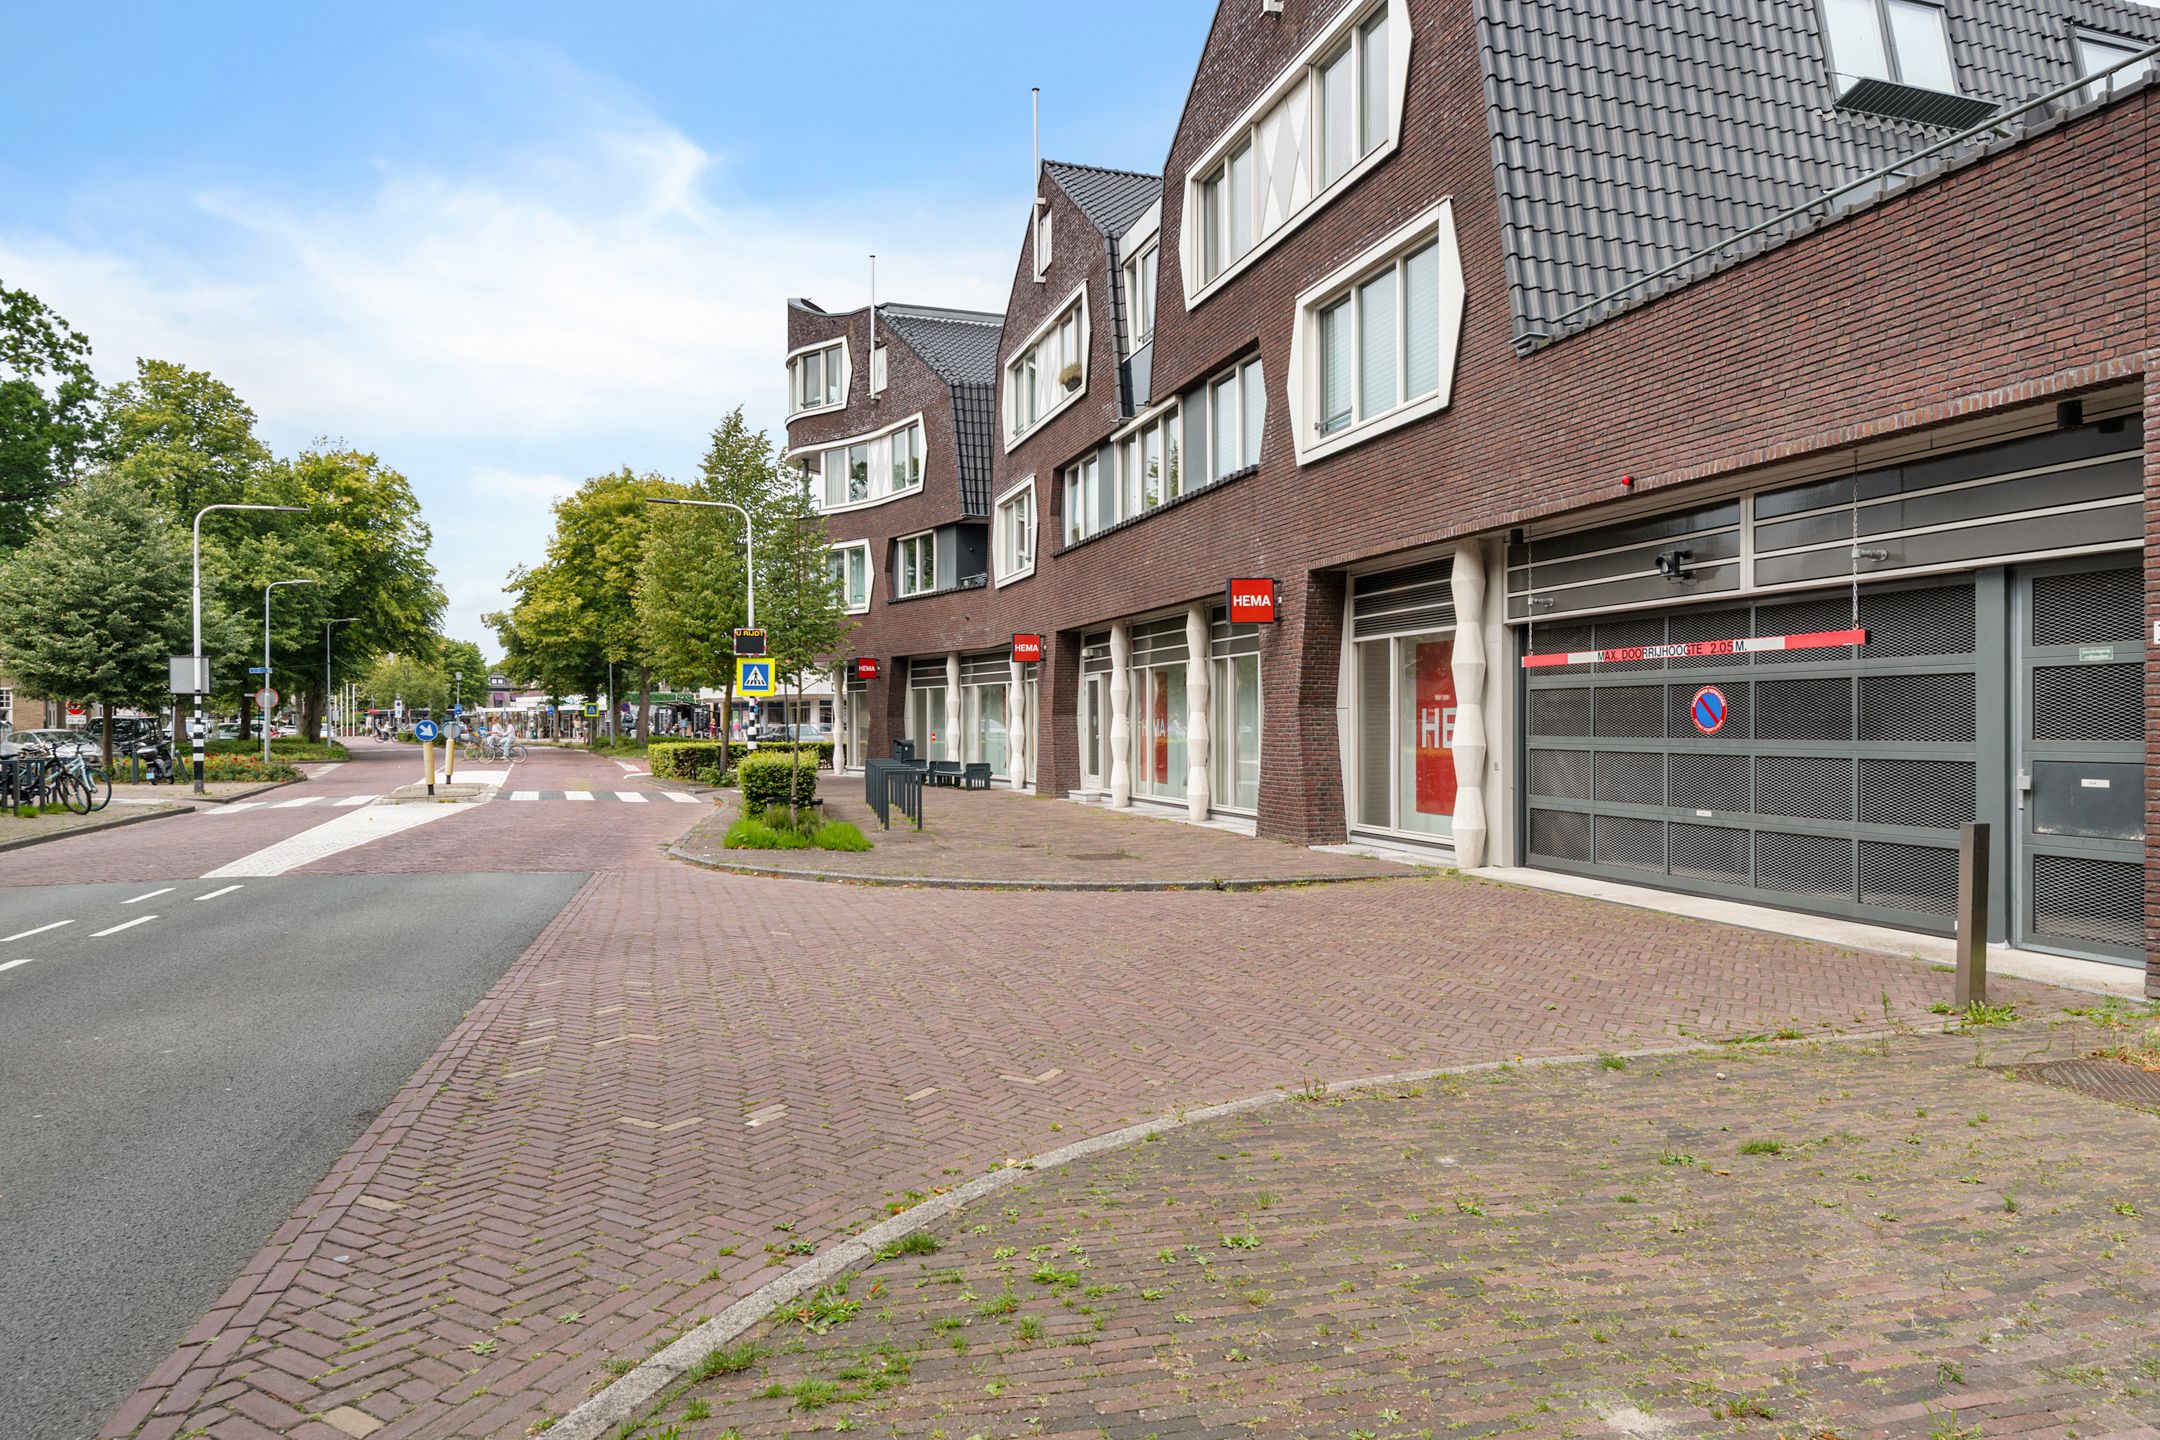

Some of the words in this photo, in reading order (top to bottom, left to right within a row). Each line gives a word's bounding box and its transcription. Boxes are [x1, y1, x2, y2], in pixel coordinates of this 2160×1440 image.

[1233, 594, 1272, 607] HEMA
[1014, 643, 1039, 652] HEMA
[1597, 651, 1619, 661] MAX.
[1621, 643, 1703, 660] DOORRIJHOOGTE
[1710, 642, 1734, 654] 2.05
[1141, 718, 1167, 737] HMA
